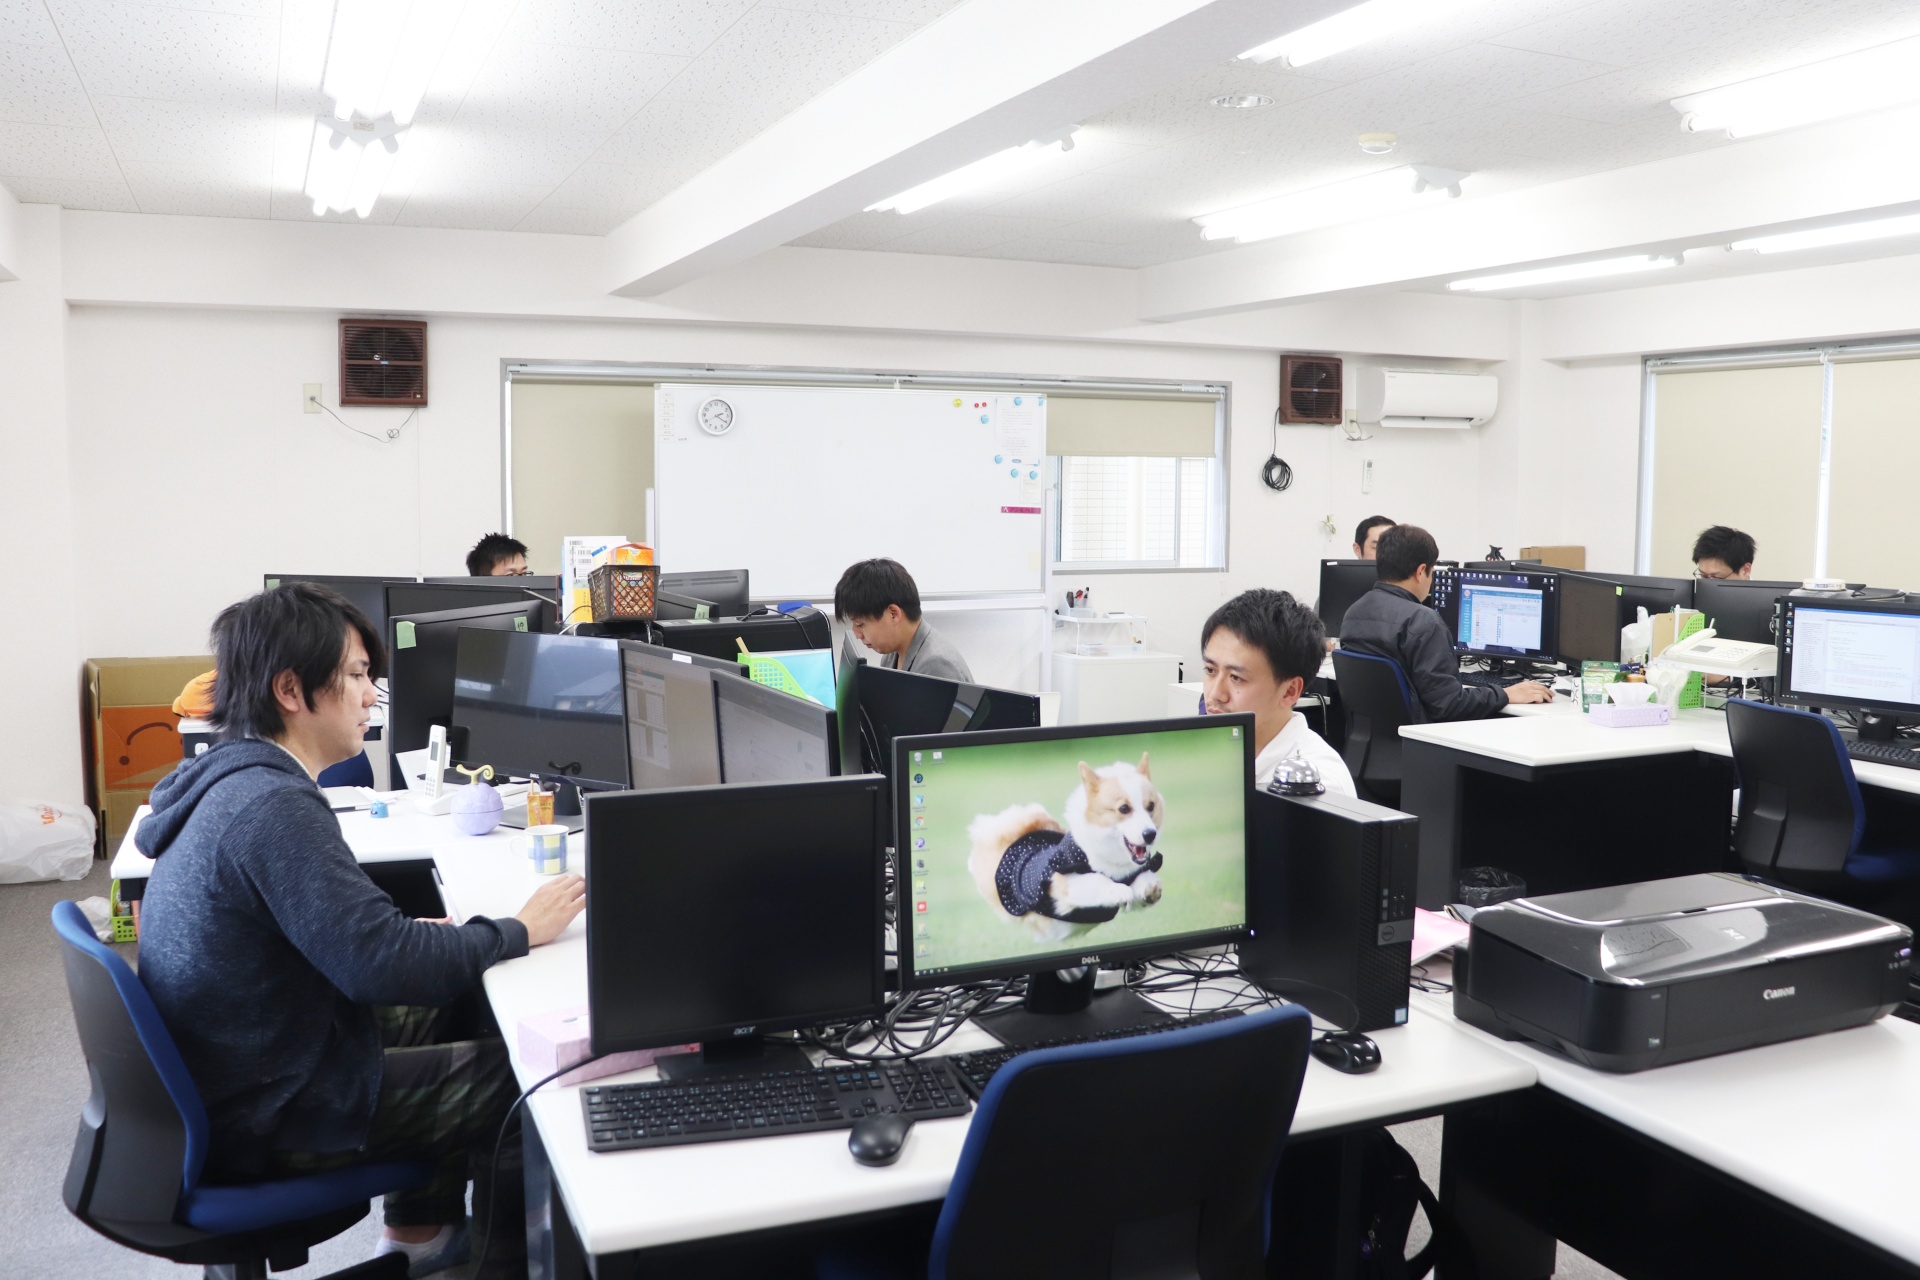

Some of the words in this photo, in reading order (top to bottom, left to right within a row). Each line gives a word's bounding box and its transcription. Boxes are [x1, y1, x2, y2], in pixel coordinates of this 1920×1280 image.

[1081, 955, 1100, 964] DELL
[1763, 986, 1795, 1000] Canon
[734, 1025, 756, 1035] acer
